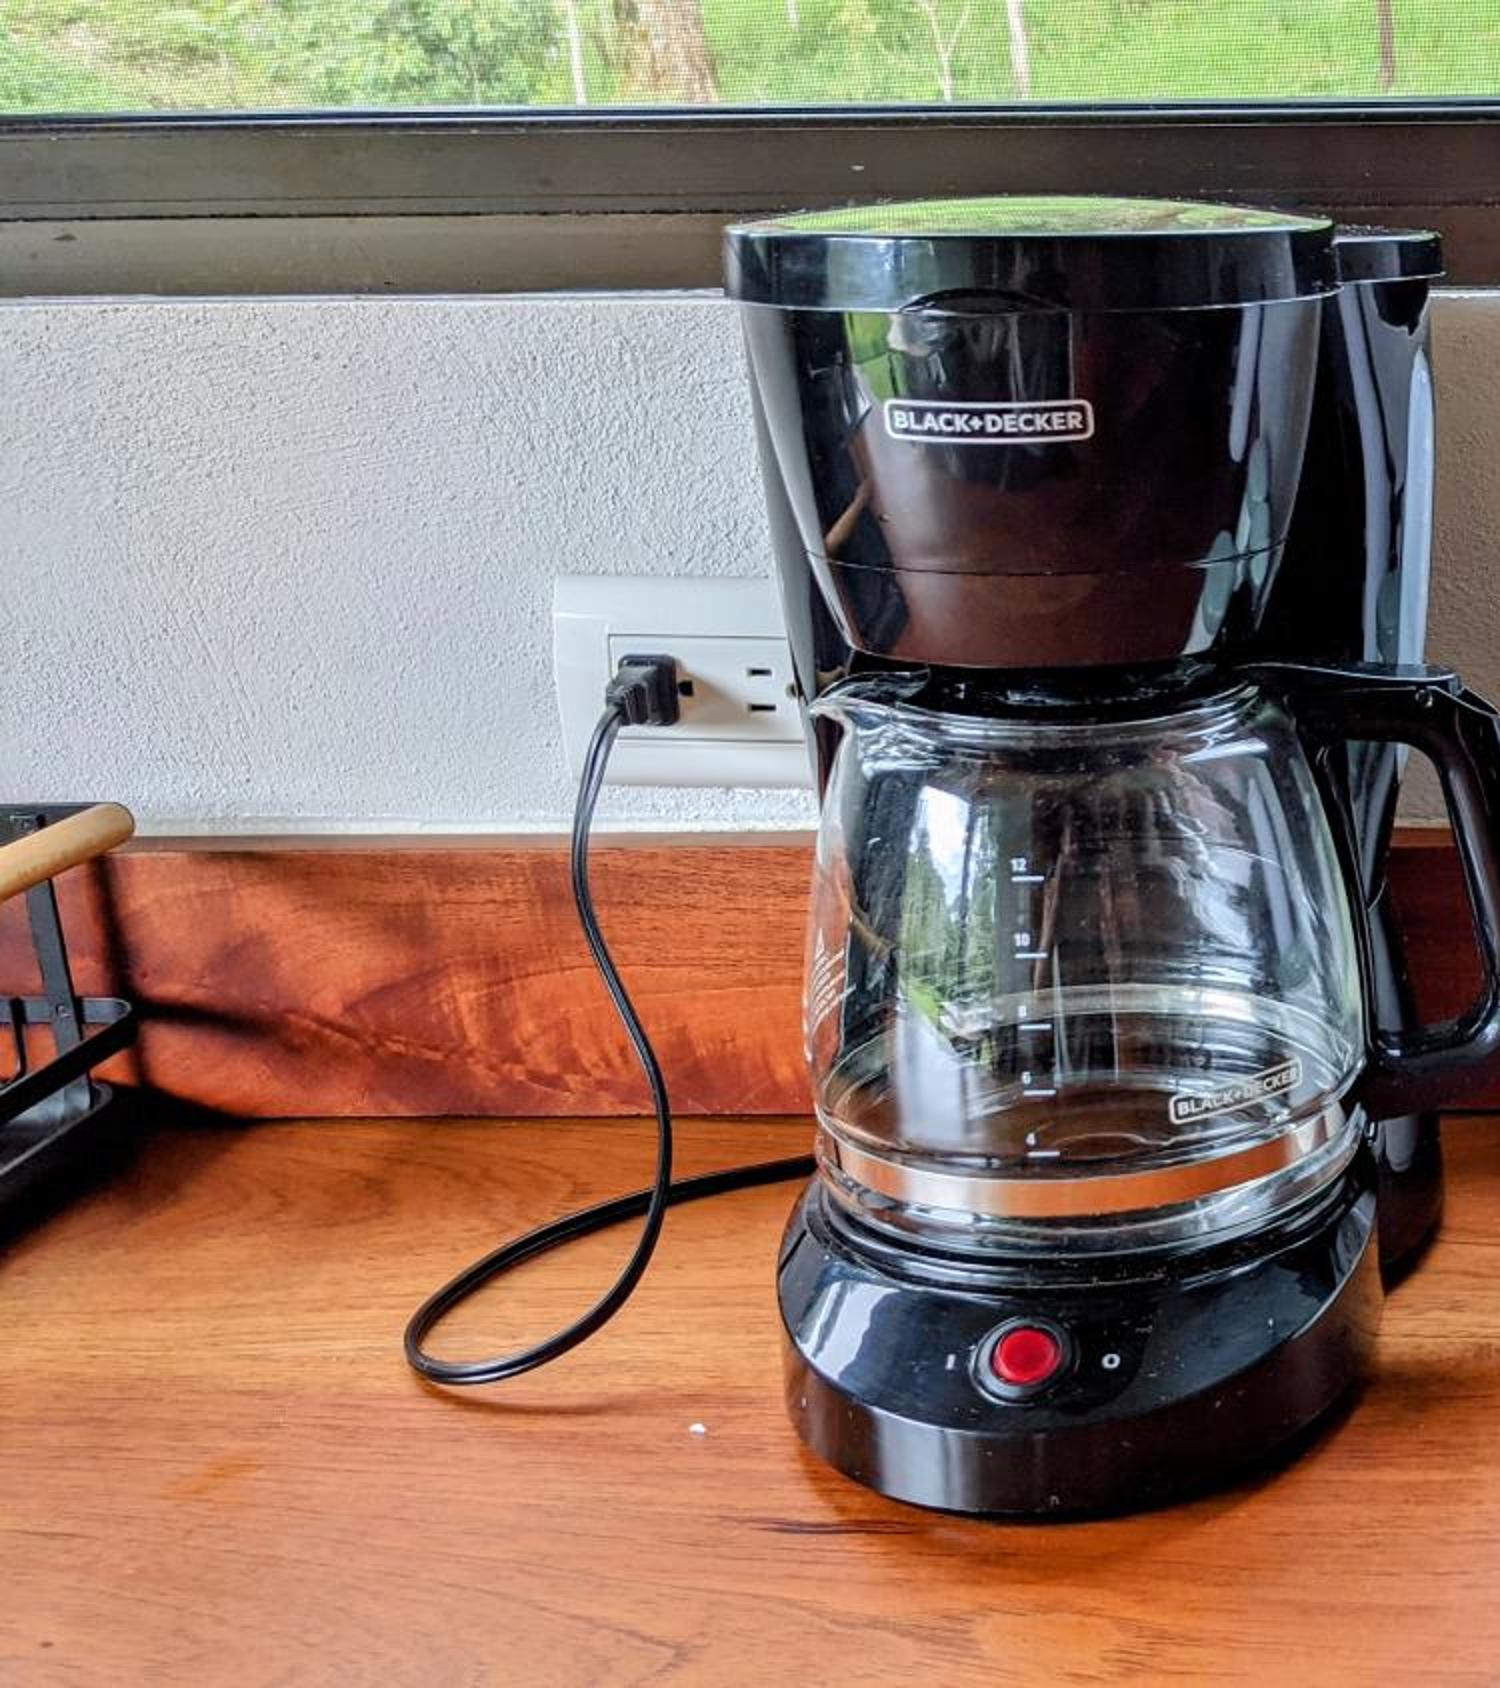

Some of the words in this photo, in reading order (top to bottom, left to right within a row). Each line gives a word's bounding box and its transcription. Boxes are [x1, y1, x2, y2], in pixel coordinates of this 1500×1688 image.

[892, 410, 1084, 433] BLACK+DECKER
[1013, 932, 1032, 948] 10
[1176, 1066, 1299, 1117] BLACK+DECKER
